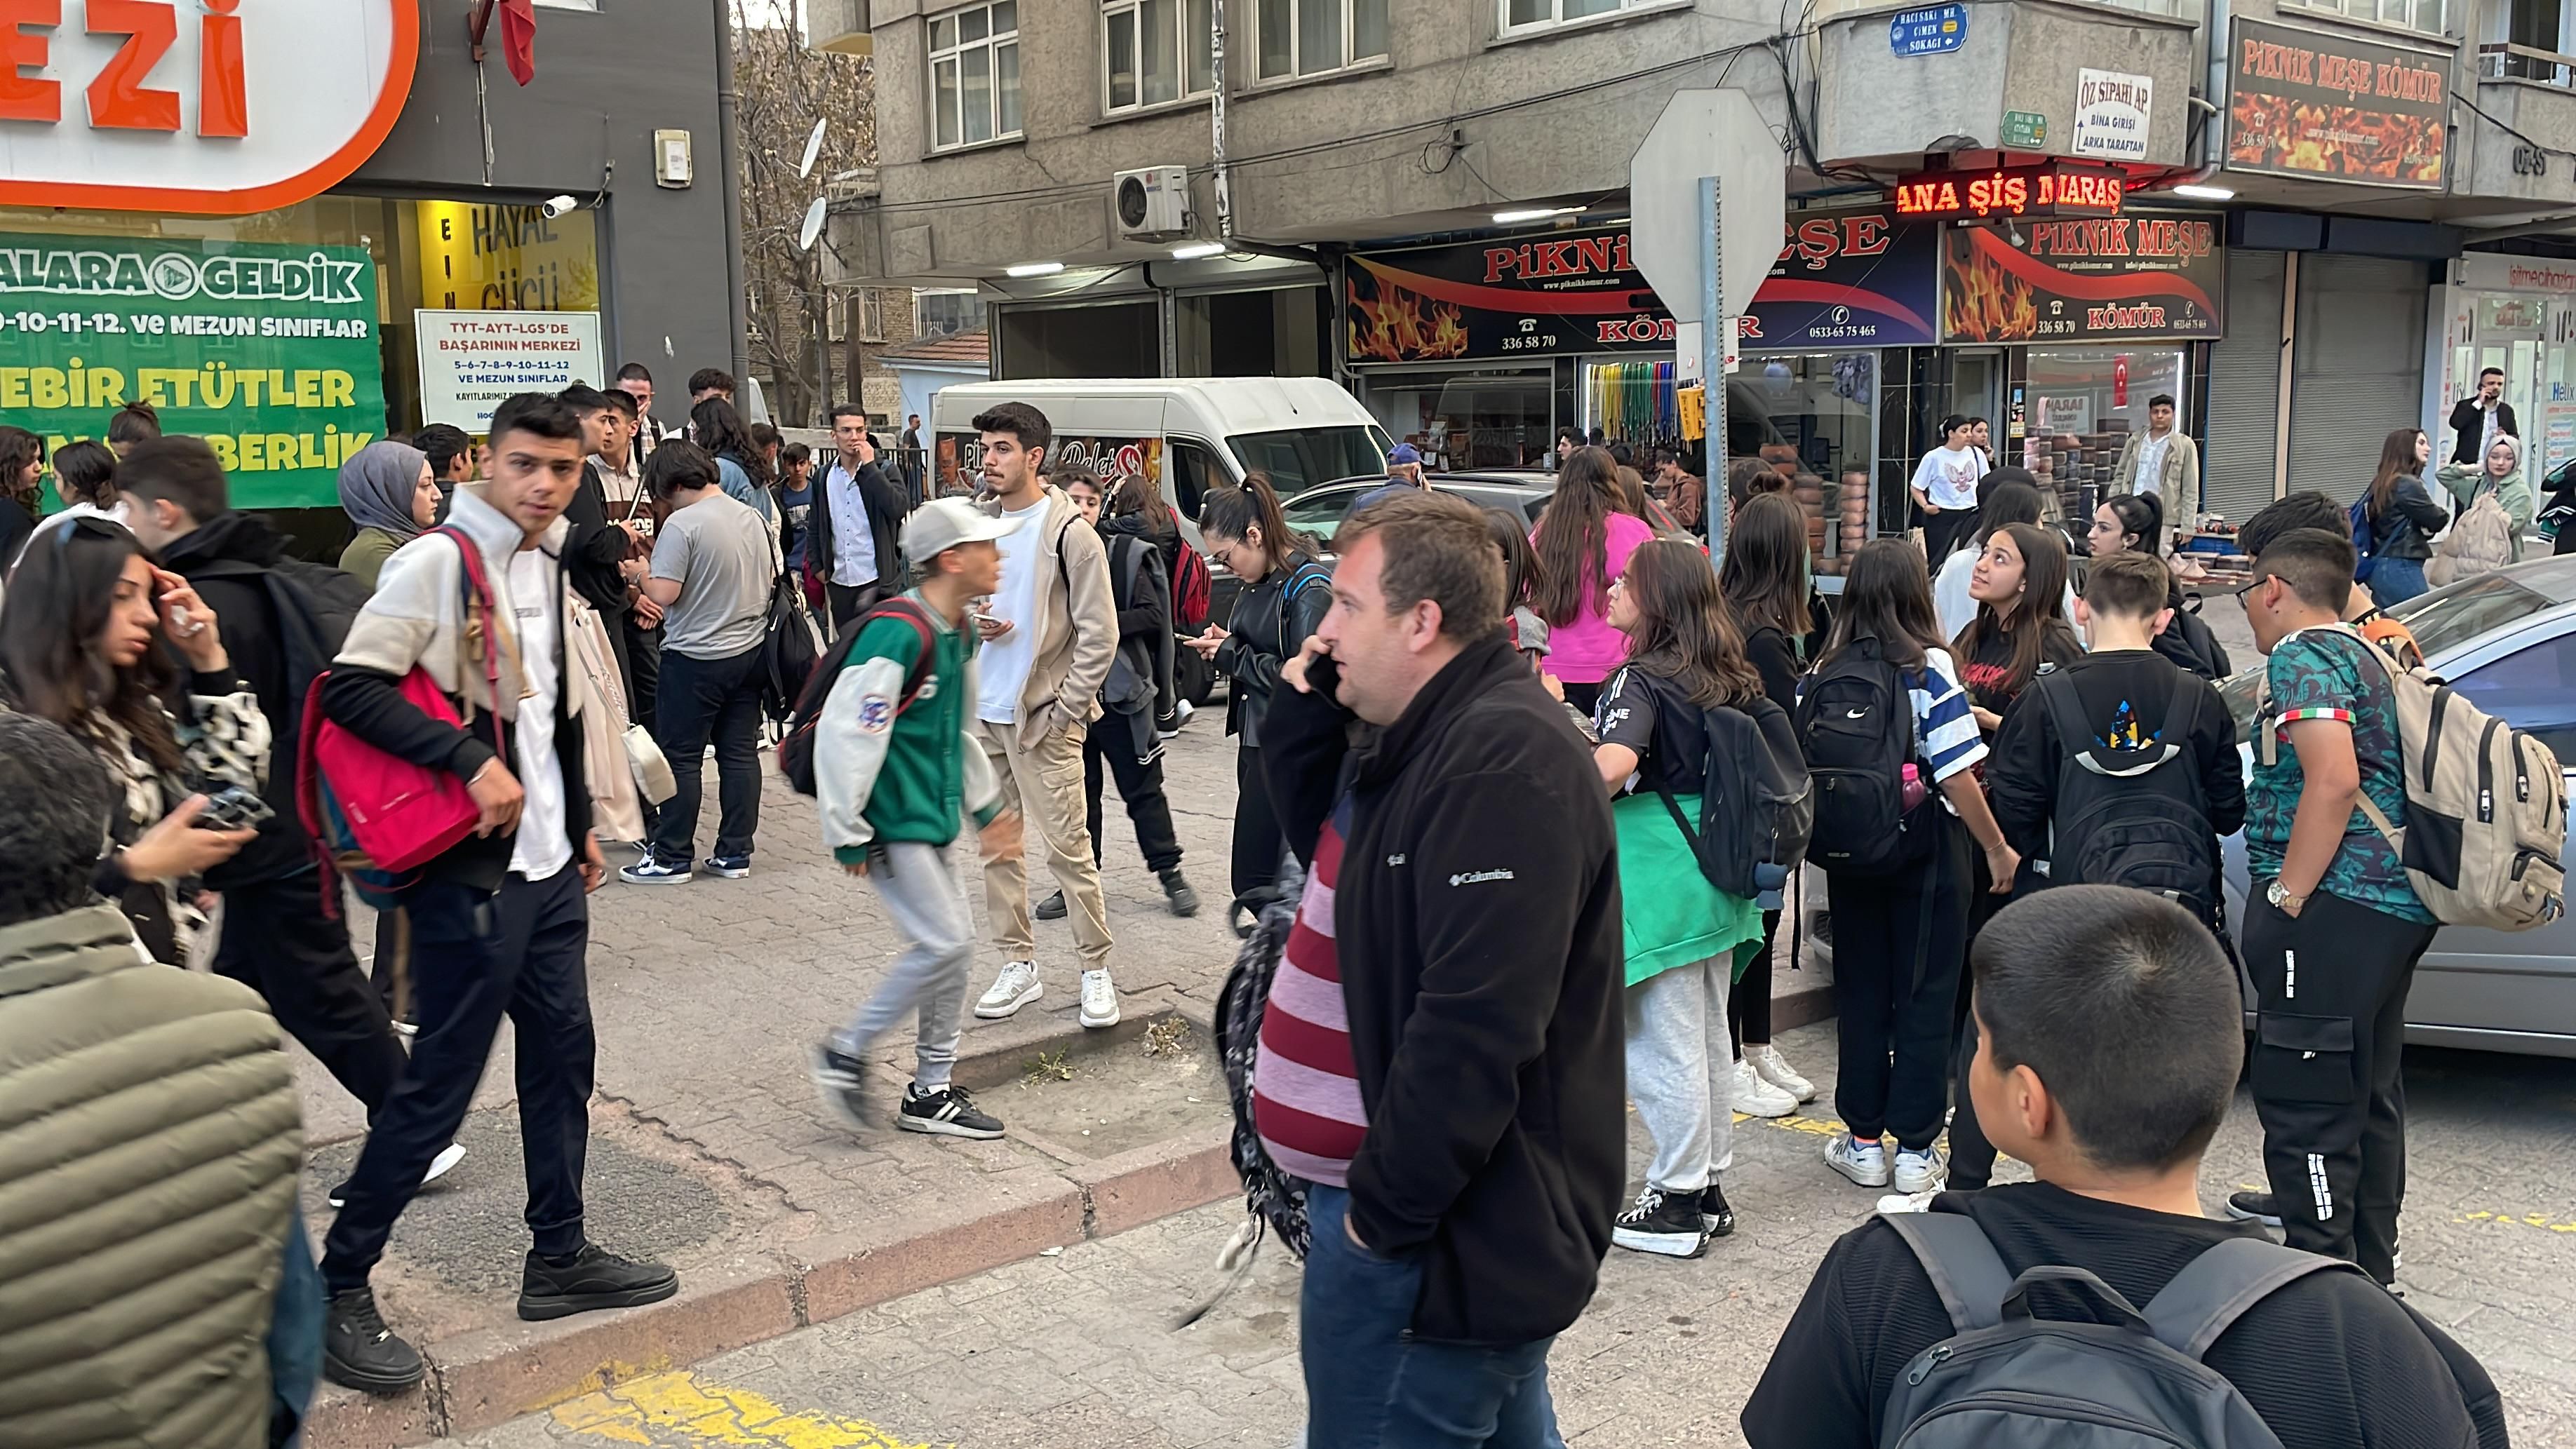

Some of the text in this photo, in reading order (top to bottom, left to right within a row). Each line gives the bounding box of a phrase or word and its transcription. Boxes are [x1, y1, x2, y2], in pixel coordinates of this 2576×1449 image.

[2316, 53, 2372, 101] MEŞE
[2375, 57, 2442, 105] KÖMÜR
[2081, 75, 2096, 110] ÖZ
[2098, 76, 2133, 107] SİPAHİ
[2091, 112, 2136, 133] BİNA GİRİŞİ
[2083, 135, 2145, 152] ARKA TARAFTAN
[1968, 171, 2027, 217] ŞİŞ
[471, 204, 558, 257] HAYAL
[2136, 219, 2211, 267] MEŞE
[199, 251, 364, 304] GELDİK
[0, 311, 127, 334] -10-11-12.
[170, 315, 256, 336] MEZUN
[260, 316, 368, 338] SINIFLAR
[2037, 319, 2076, 334] 336 58 70
[2086, 302, 2166, 330] KÖMÜR
[1809, 325, 1876, 338] 0533-65 75 465
[439, 338, 581, 353] BAŞARININ MERKEZİ
[1502, 335, 1556, 350] 336 58 70
[455, 360, 570, 370] 5-6-7-8-9-10-11-12
[137, 361, 356, 408] ETÜTLER
[458, 375, 568, 383] VE MEZUN SINIFLAR
[456, 391, 507, 401] KAYITLARIMIZ
[2553, 382, 2575, 402] Helix
